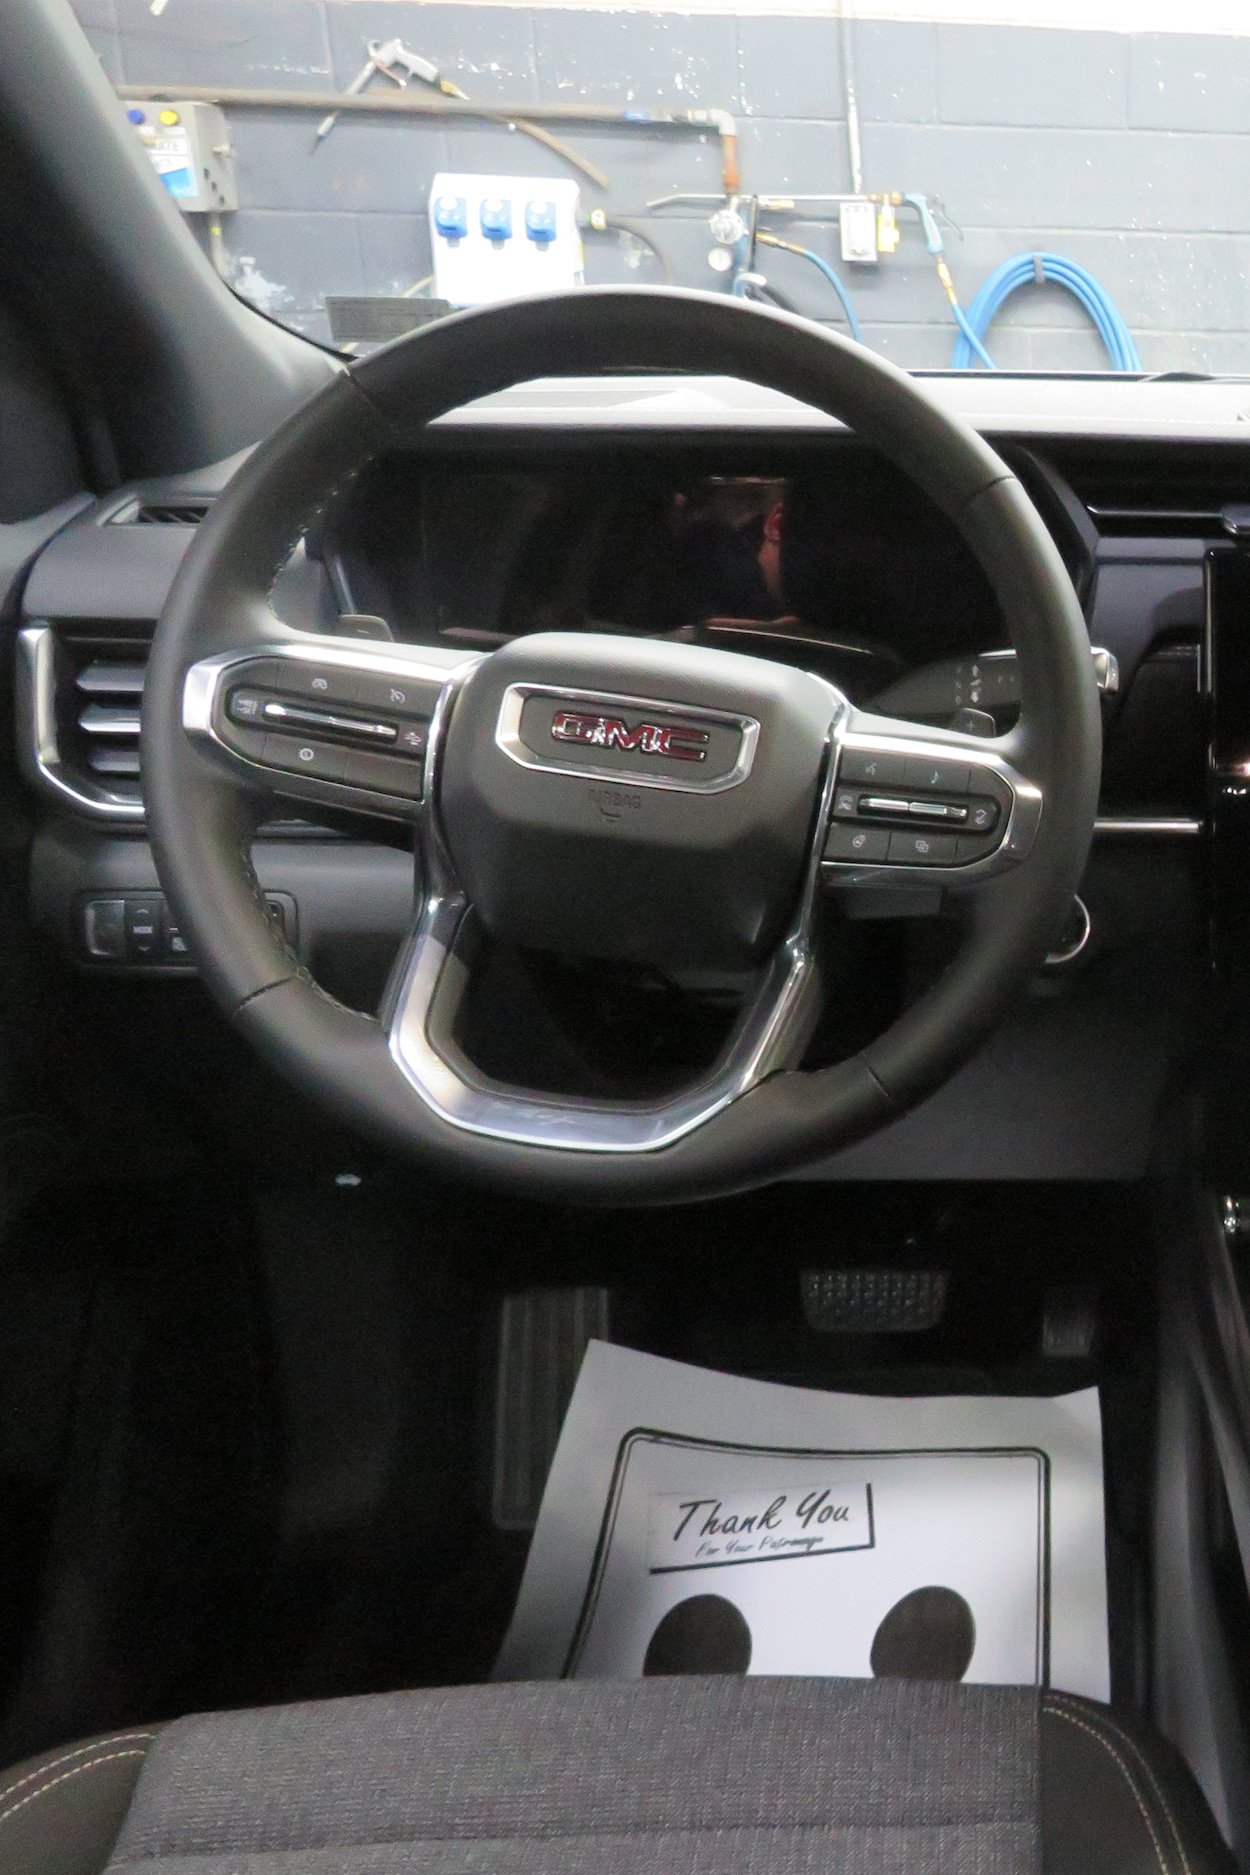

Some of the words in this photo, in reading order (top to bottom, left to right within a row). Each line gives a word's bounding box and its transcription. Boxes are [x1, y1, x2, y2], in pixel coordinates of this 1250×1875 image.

[551, 712, 710, 762] GMC
[673, 1494, 787, 1541] Thank
[796, 1488, 849, 1529] You
[726, 1538, 754, 1554] Your
